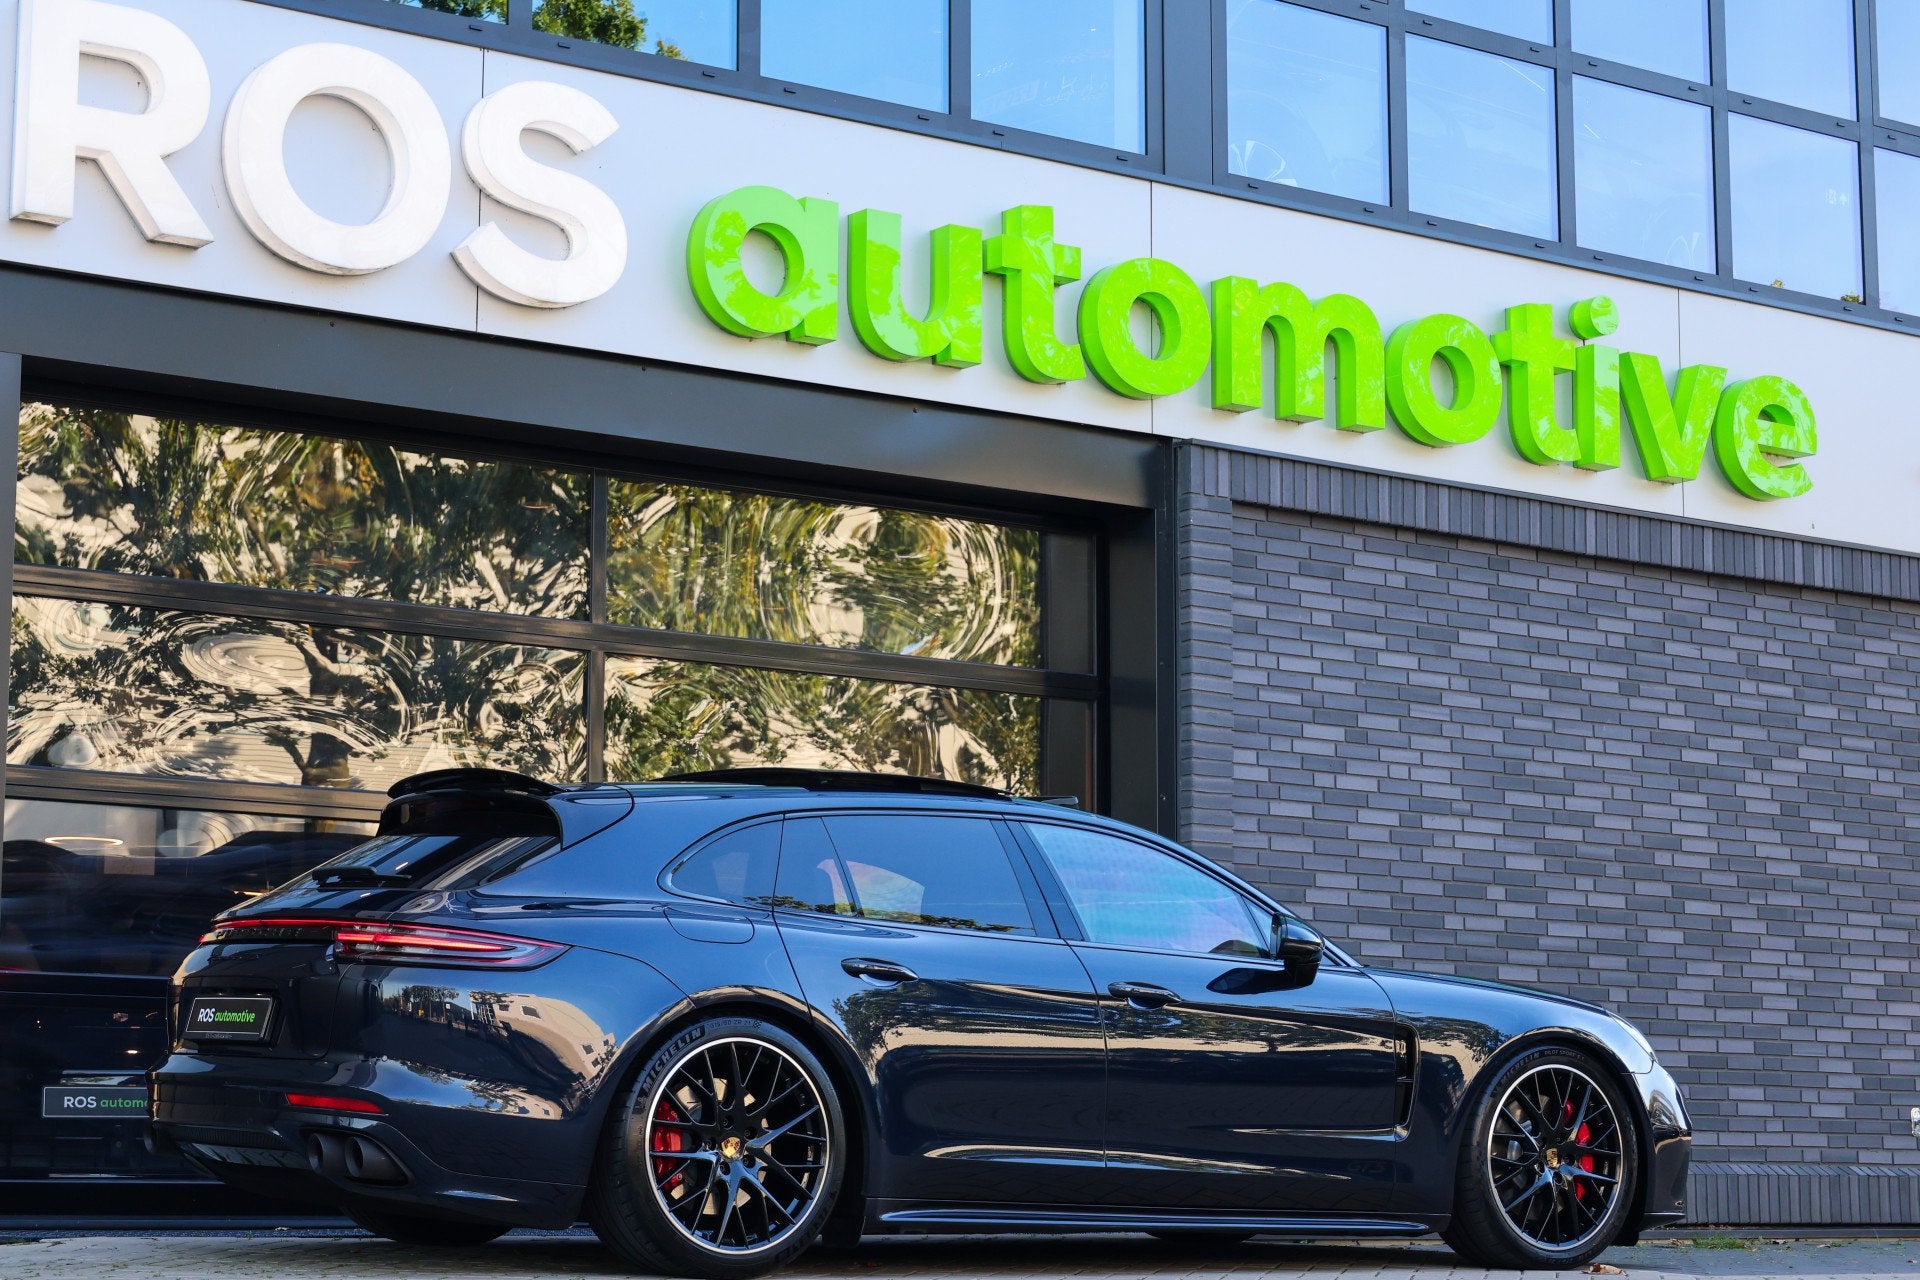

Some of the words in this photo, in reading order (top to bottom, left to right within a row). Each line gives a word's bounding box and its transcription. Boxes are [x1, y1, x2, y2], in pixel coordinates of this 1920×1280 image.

[10, 0, 627, 309] ROS
[687, 185, 1819, 500] automotive
[197, 1008, 216, 1022] ROS
[214, 1010, 256, 1022] automotive
[642, 1027, 702, 1093] MICHELIN
[63, 1096, 97, 1108] ROS
